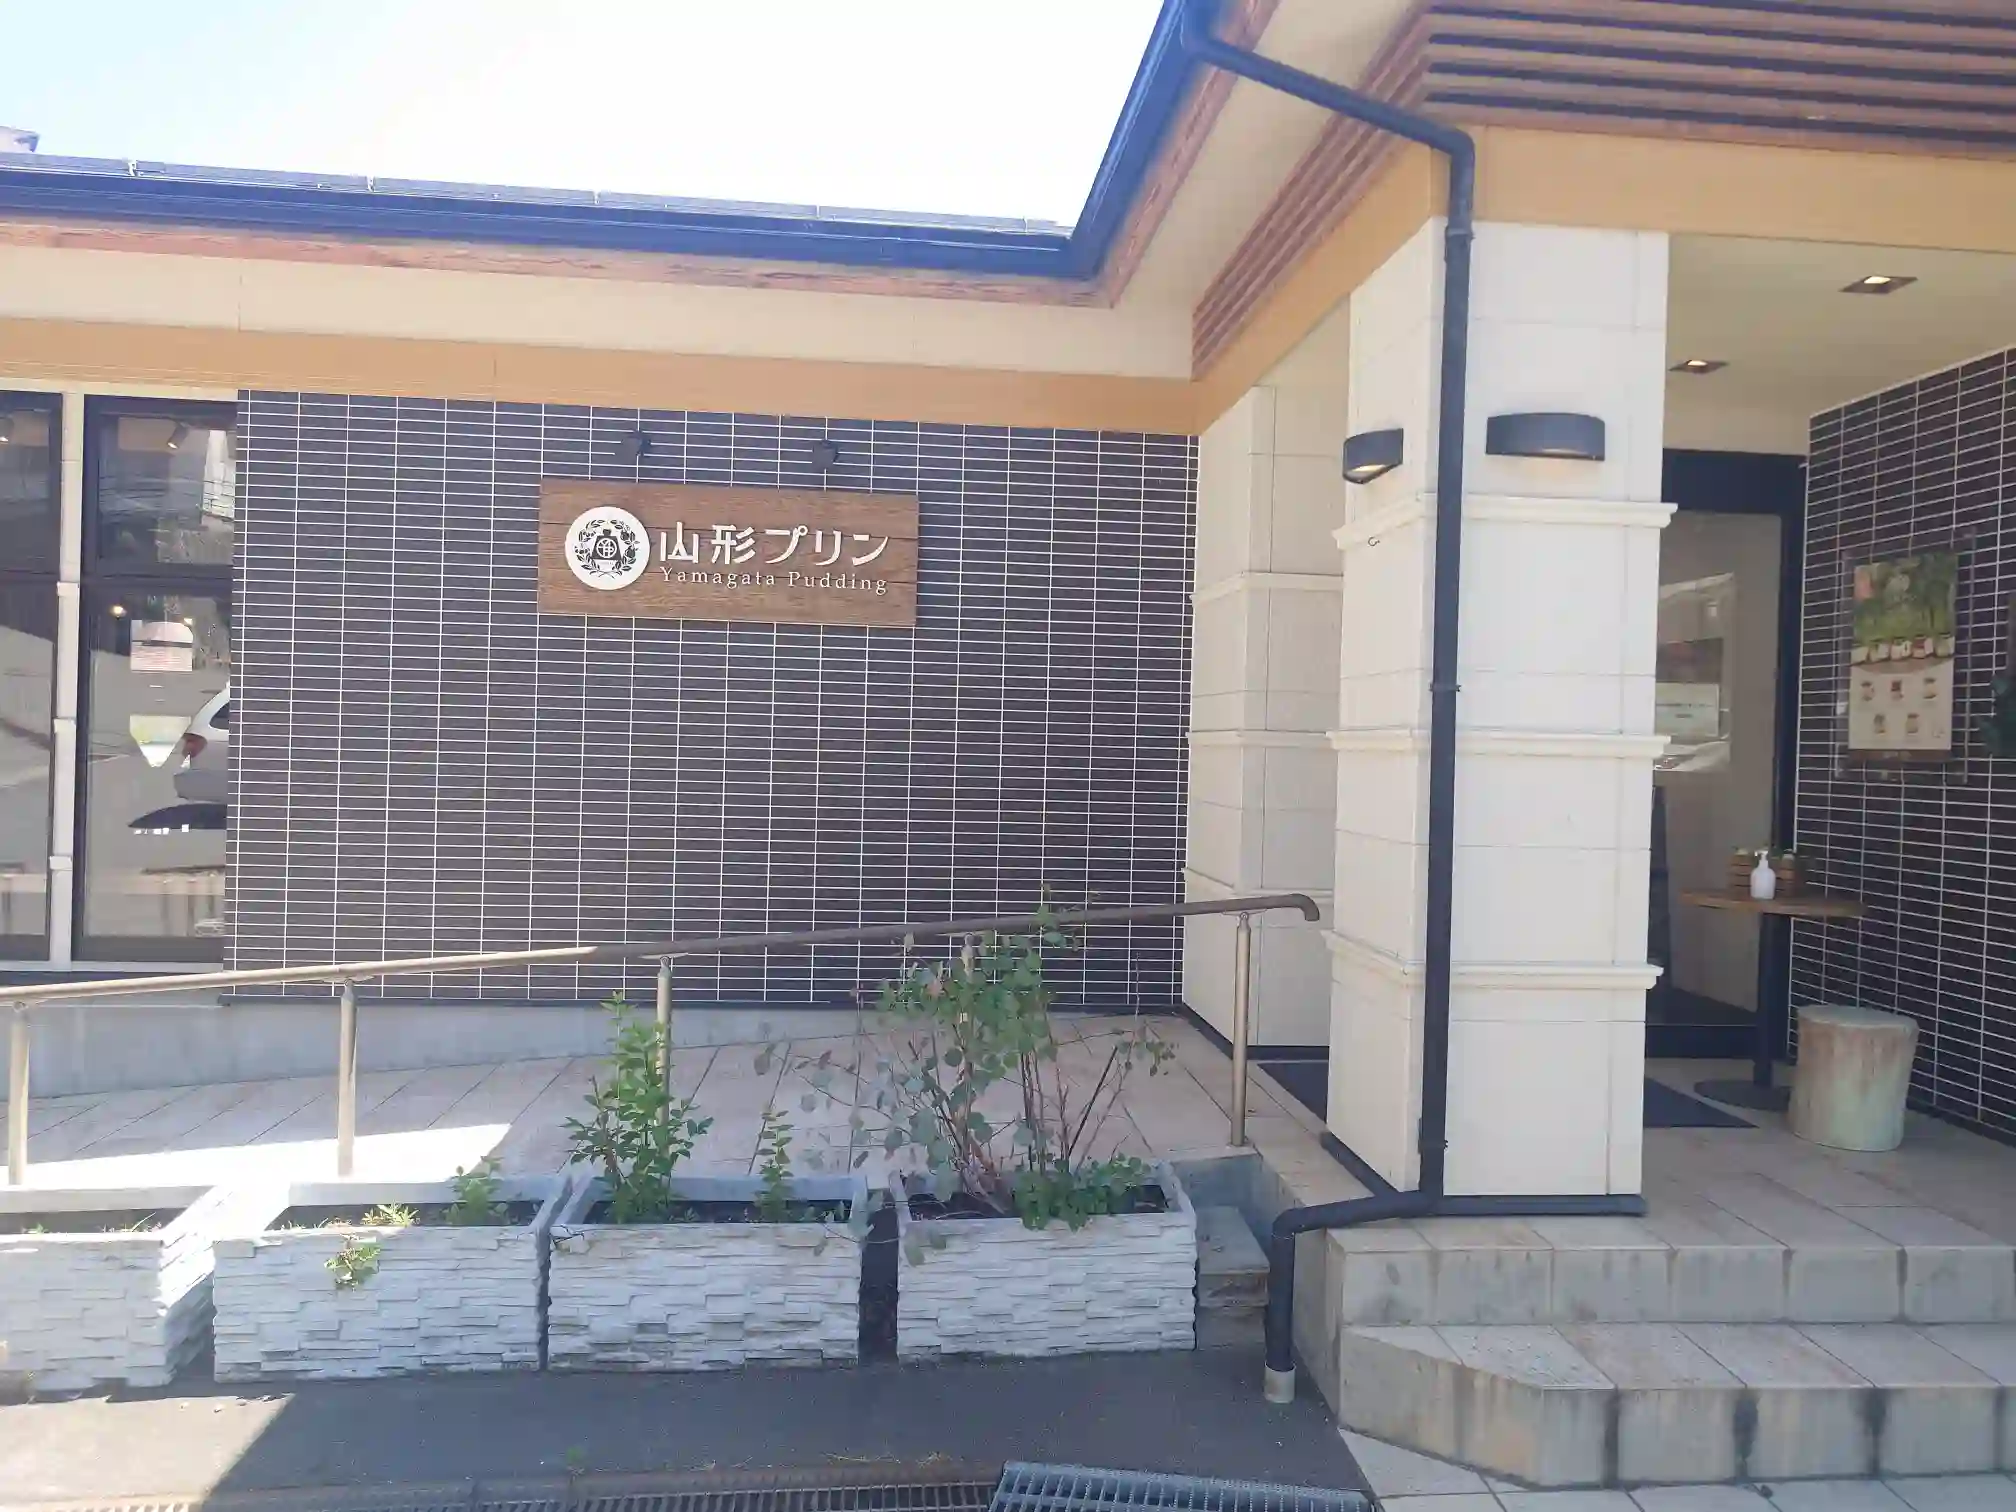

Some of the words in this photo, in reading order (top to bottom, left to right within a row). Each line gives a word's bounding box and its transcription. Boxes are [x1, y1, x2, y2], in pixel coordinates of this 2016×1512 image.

[659, 521, 889, 566] 山形プリン
[659, 566, 776, 589] Yamagata
[787, 571, 888, 595] Pudding
